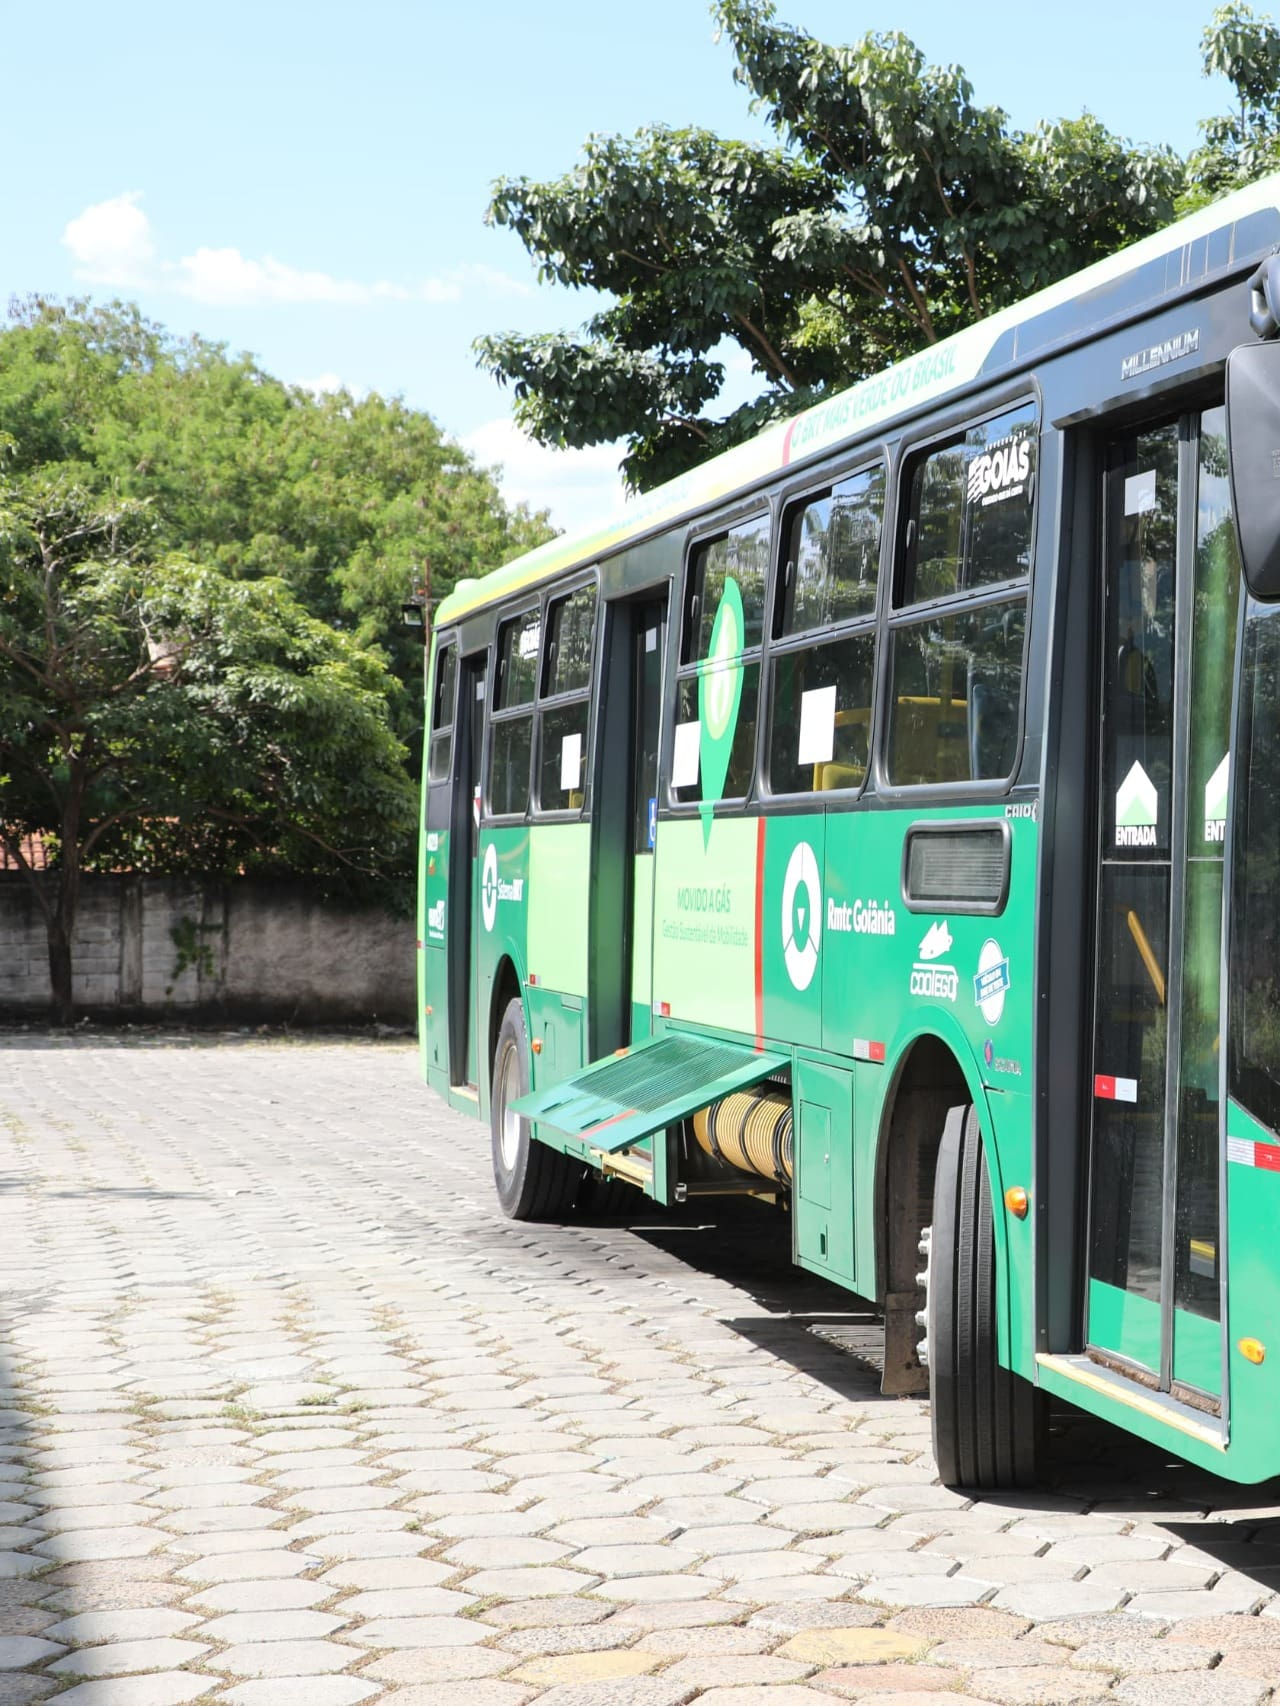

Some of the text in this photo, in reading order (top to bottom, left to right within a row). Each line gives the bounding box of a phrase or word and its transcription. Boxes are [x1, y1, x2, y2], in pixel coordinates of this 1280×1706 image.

[1121, 328, 1200, 380] MILLENNIUM
[801, 411, 825, 445] BRT
[822, 400, 850, 435] MAIS
[851, 379, 893, 419] VERDE
[890, 364, 914, 400] DO
[912, 344, 958, 394] BRASIL
[980, 437, 1030, 494] GOIÁS
[1005, 804, 1032, 818] CAIO
[1115, 826, 1157, 846] ENTRADA
[677, 882, 731, 913] MOVIDO A GÁS
[827, 898, 896, 936] Rmtc Goiânia
[910, 962, 959, 1002] COOTEGO
